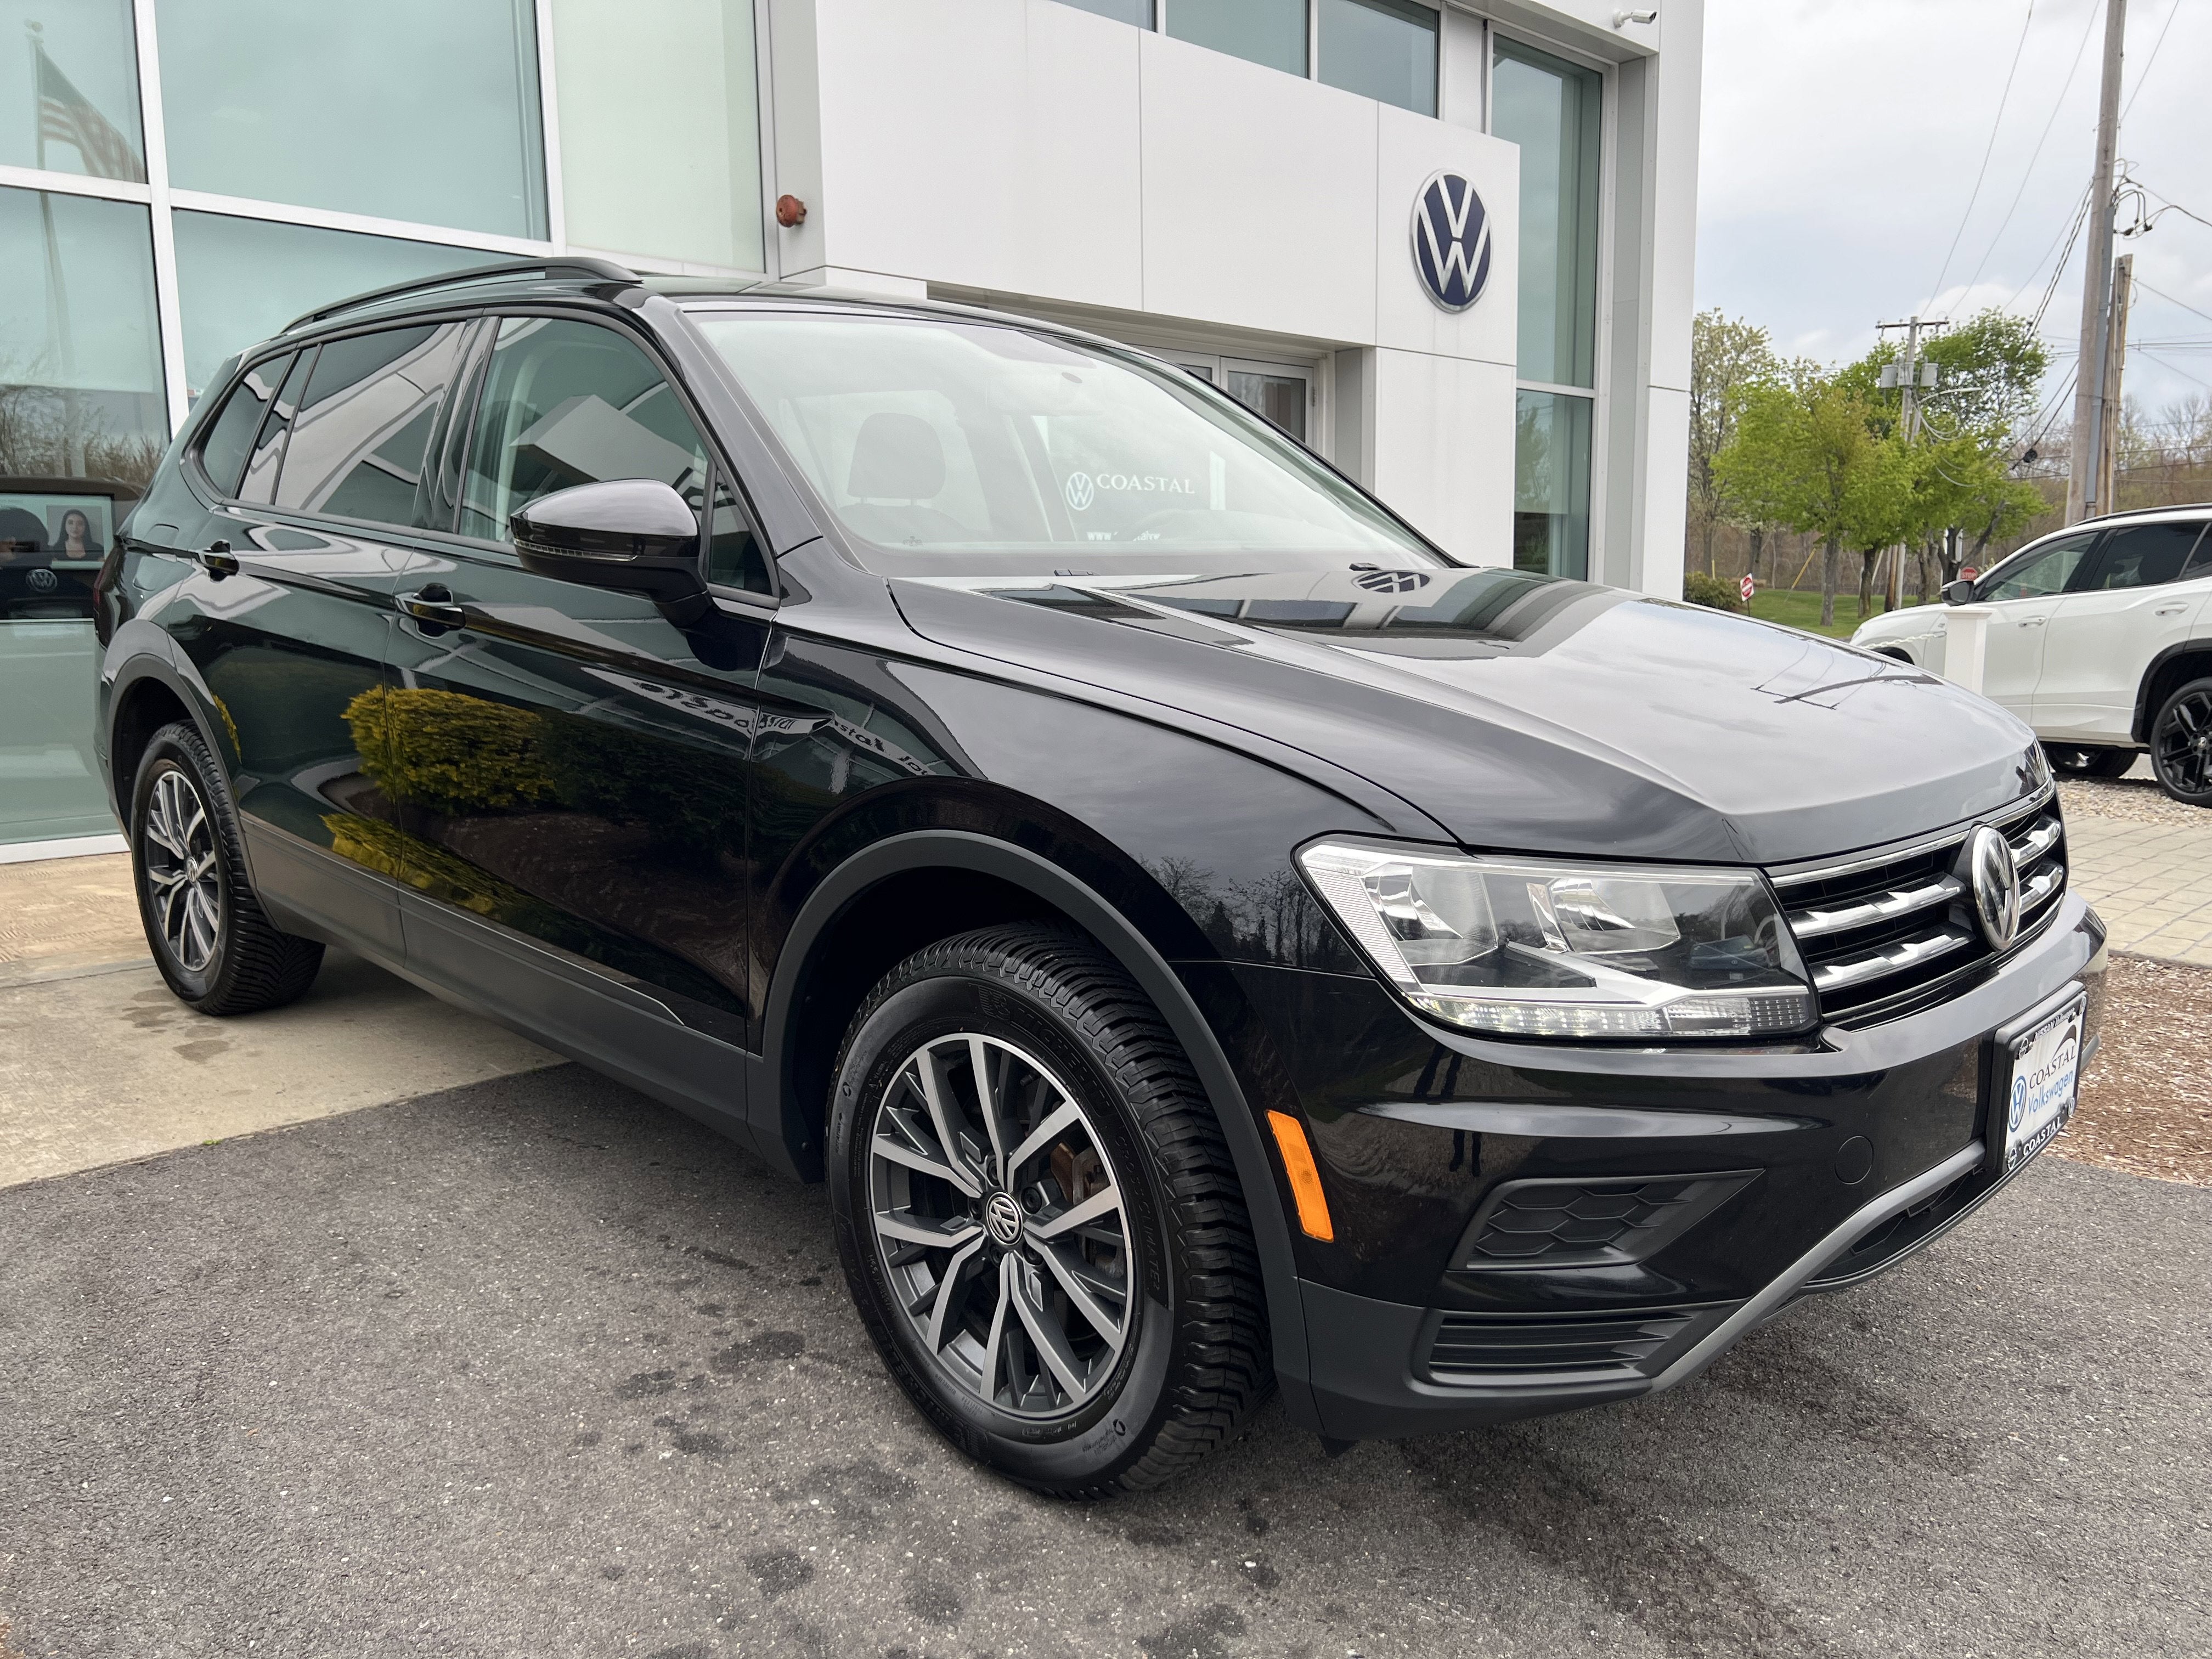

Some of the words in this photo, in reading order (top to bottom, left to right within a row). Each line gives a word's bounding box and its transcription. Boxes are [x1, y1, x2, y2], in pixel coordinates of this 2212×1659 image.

[1413, 171, 1492, 308] VW
[1097, 473, 1195, 494] COASTAL
[2029, 1045, 2076, 1090] COASTAL
[2009, 1075, 2027, 1133] VW
[2028, 1070, 2073, 1115] Volkswagen
[2023, 1116, 2062, 1156] COASTAL
